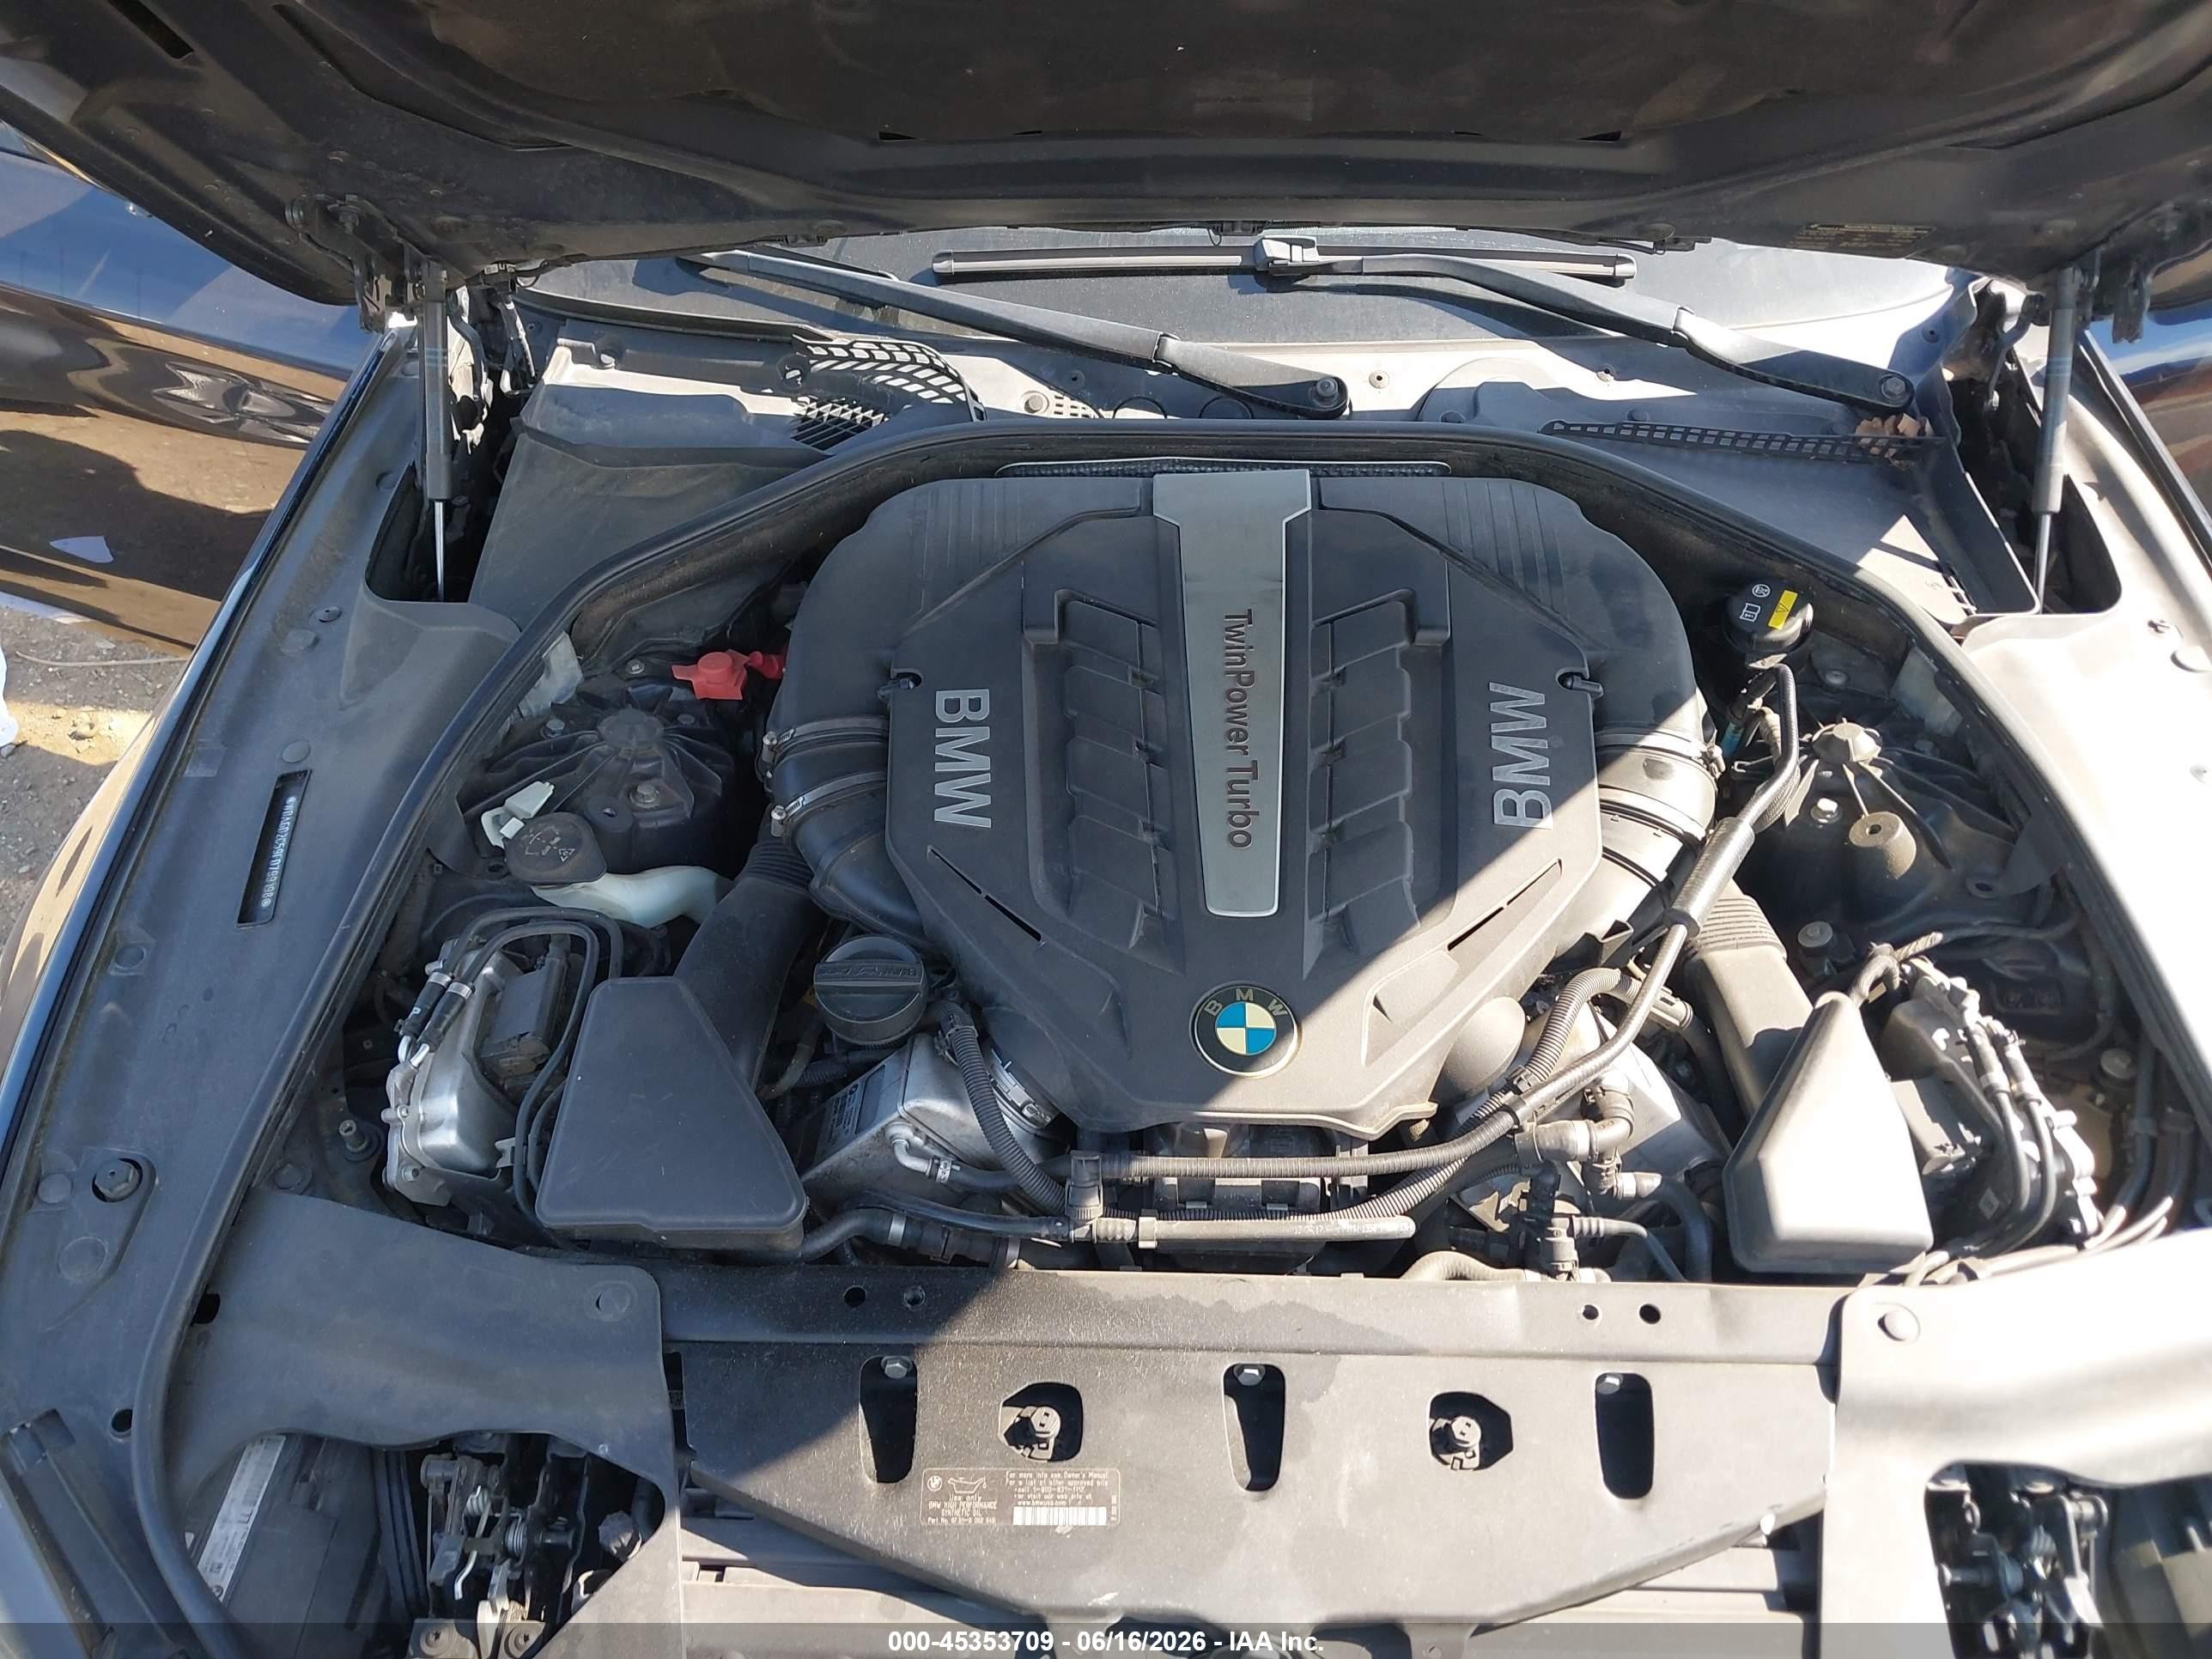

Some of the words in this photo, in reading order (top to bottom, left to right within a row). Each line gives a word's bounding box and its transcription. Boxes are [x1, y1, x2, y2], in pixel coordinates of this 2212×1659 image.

[1224, 608, 1255, 756] TwinPower
[934, 689, 992, 829] BMW
[1226, 760, 1260, 849] Turbo
[1490, 682, 1553, 830] BMW
[1204, 988, 1288, 1016] BMW
